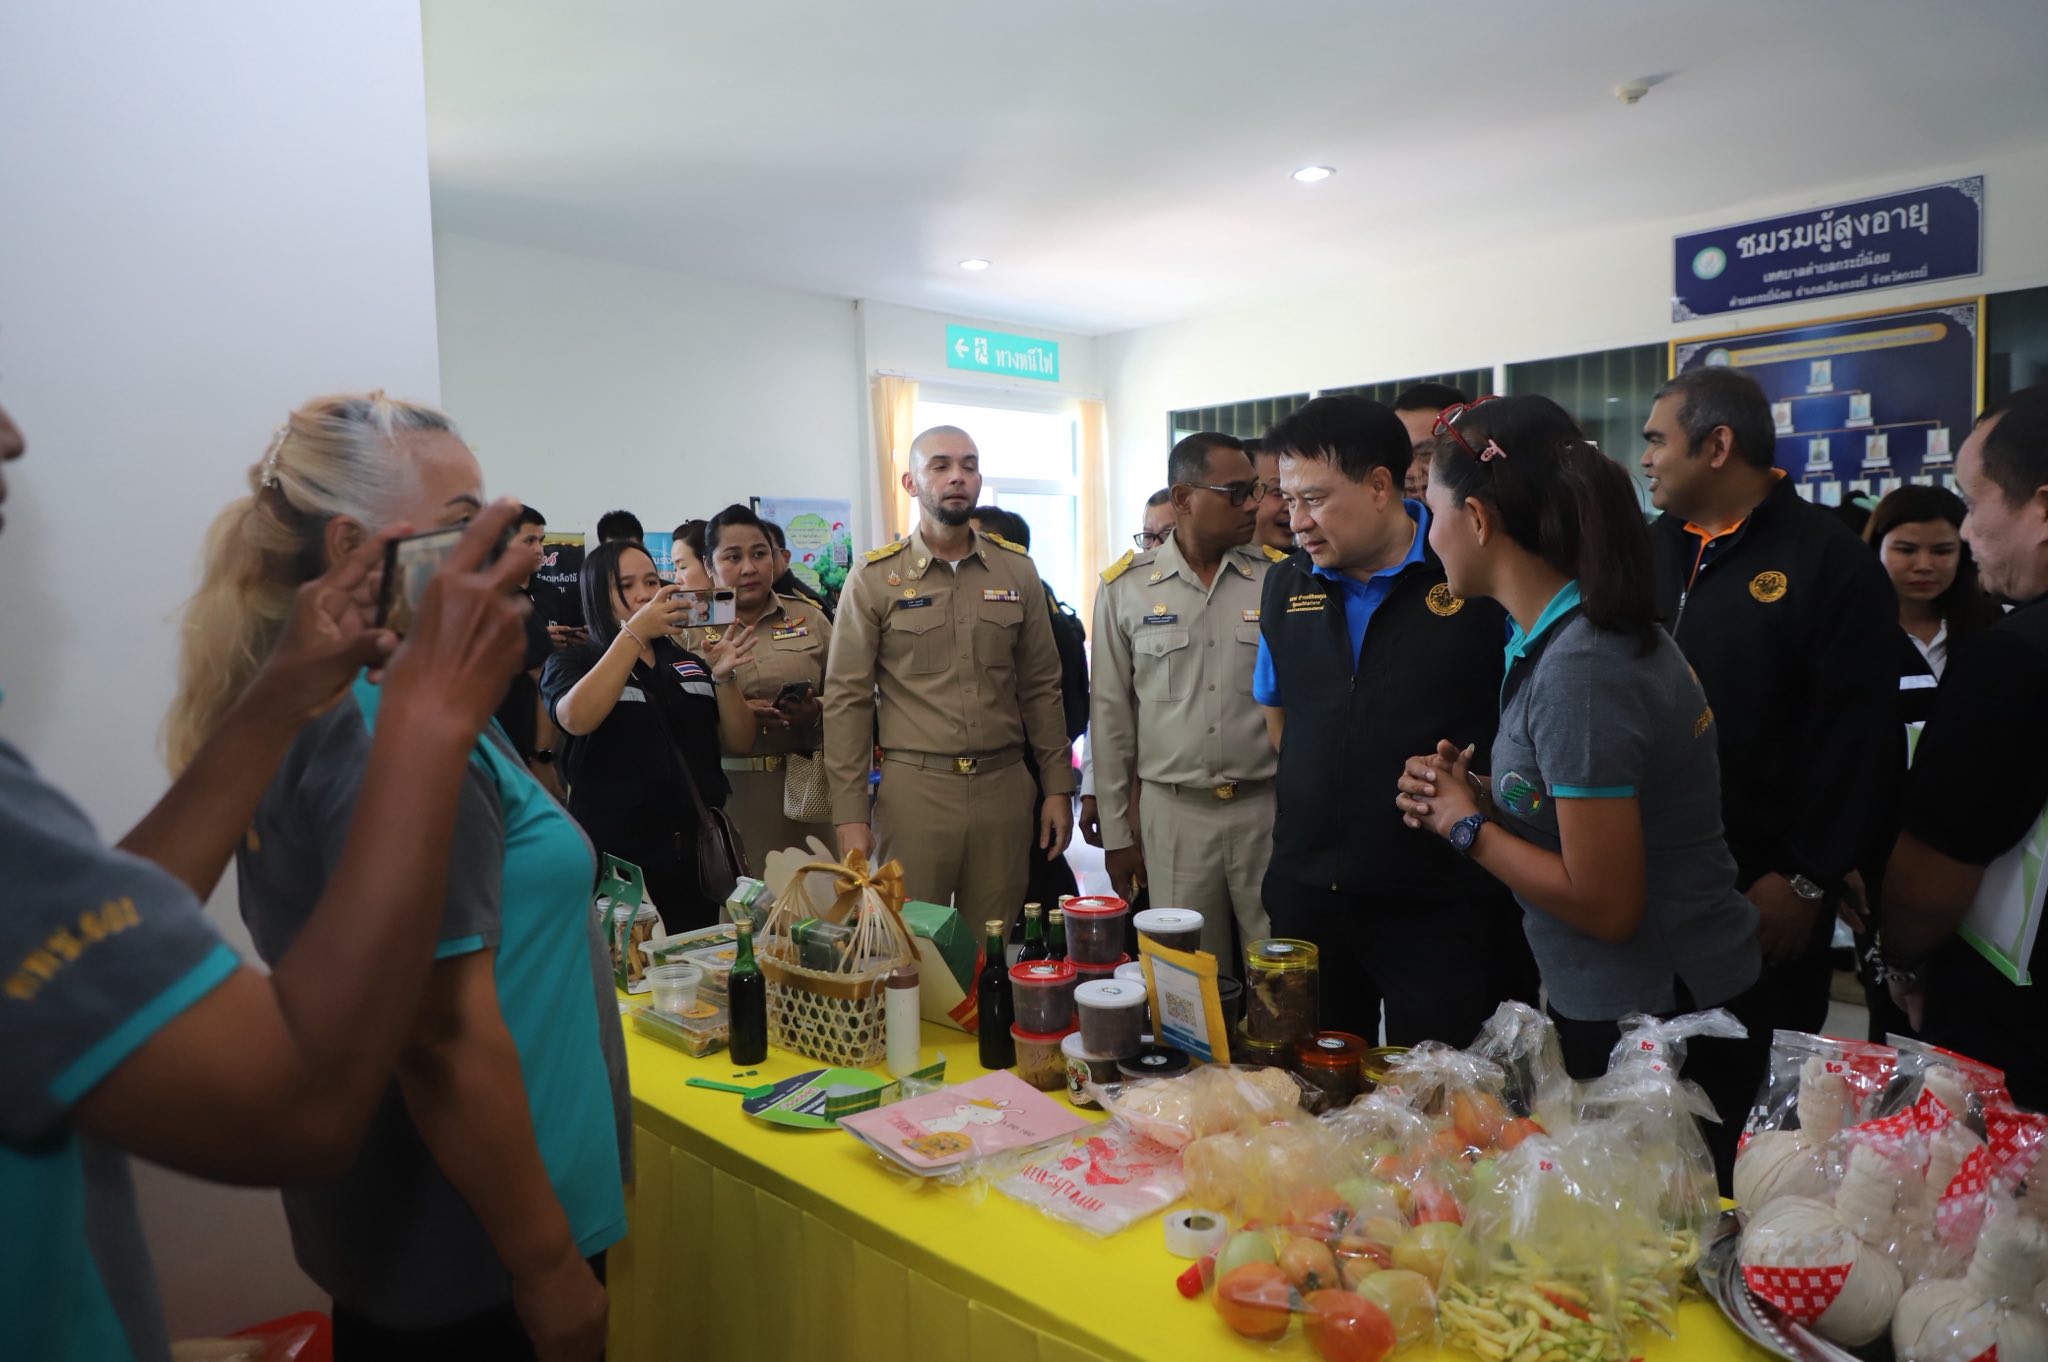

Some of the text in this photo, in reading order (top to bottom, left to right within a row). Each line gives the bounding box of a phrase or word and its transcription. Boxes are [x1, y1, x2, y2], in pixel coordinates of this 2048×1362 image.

[1736, 201, 1929, 259] ชมรมผู้สูงอายุ
[995, 347, 1053, 375] ทางหนีไฟ
